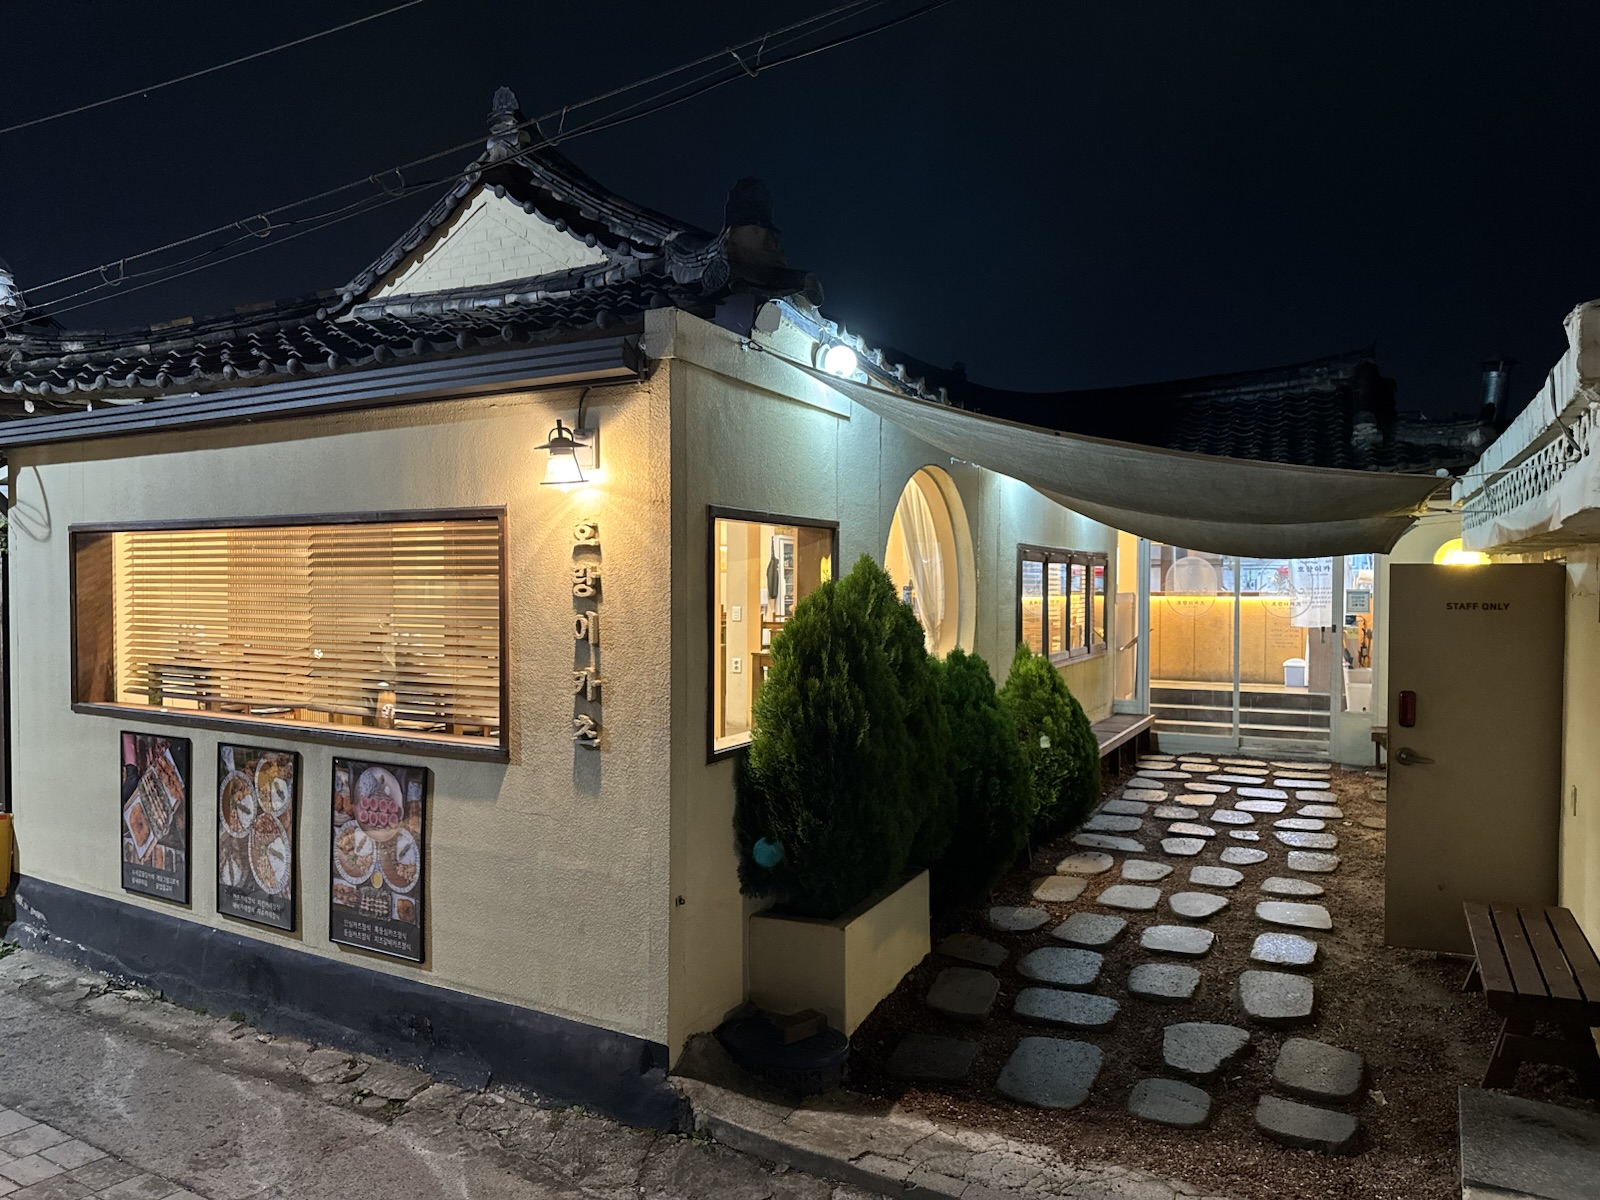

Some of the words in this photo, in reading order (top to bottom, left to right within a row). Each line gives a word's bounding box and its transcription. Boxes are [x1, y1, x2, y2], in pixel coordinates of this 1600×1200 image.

[1297, 565, 1331, 573] 호랑이카
[1446, 602, 1479, 611] STAFF
[1482, 602, 1510, 611] ONLY
[573, 518, 601, 749] 호랑이카츠
